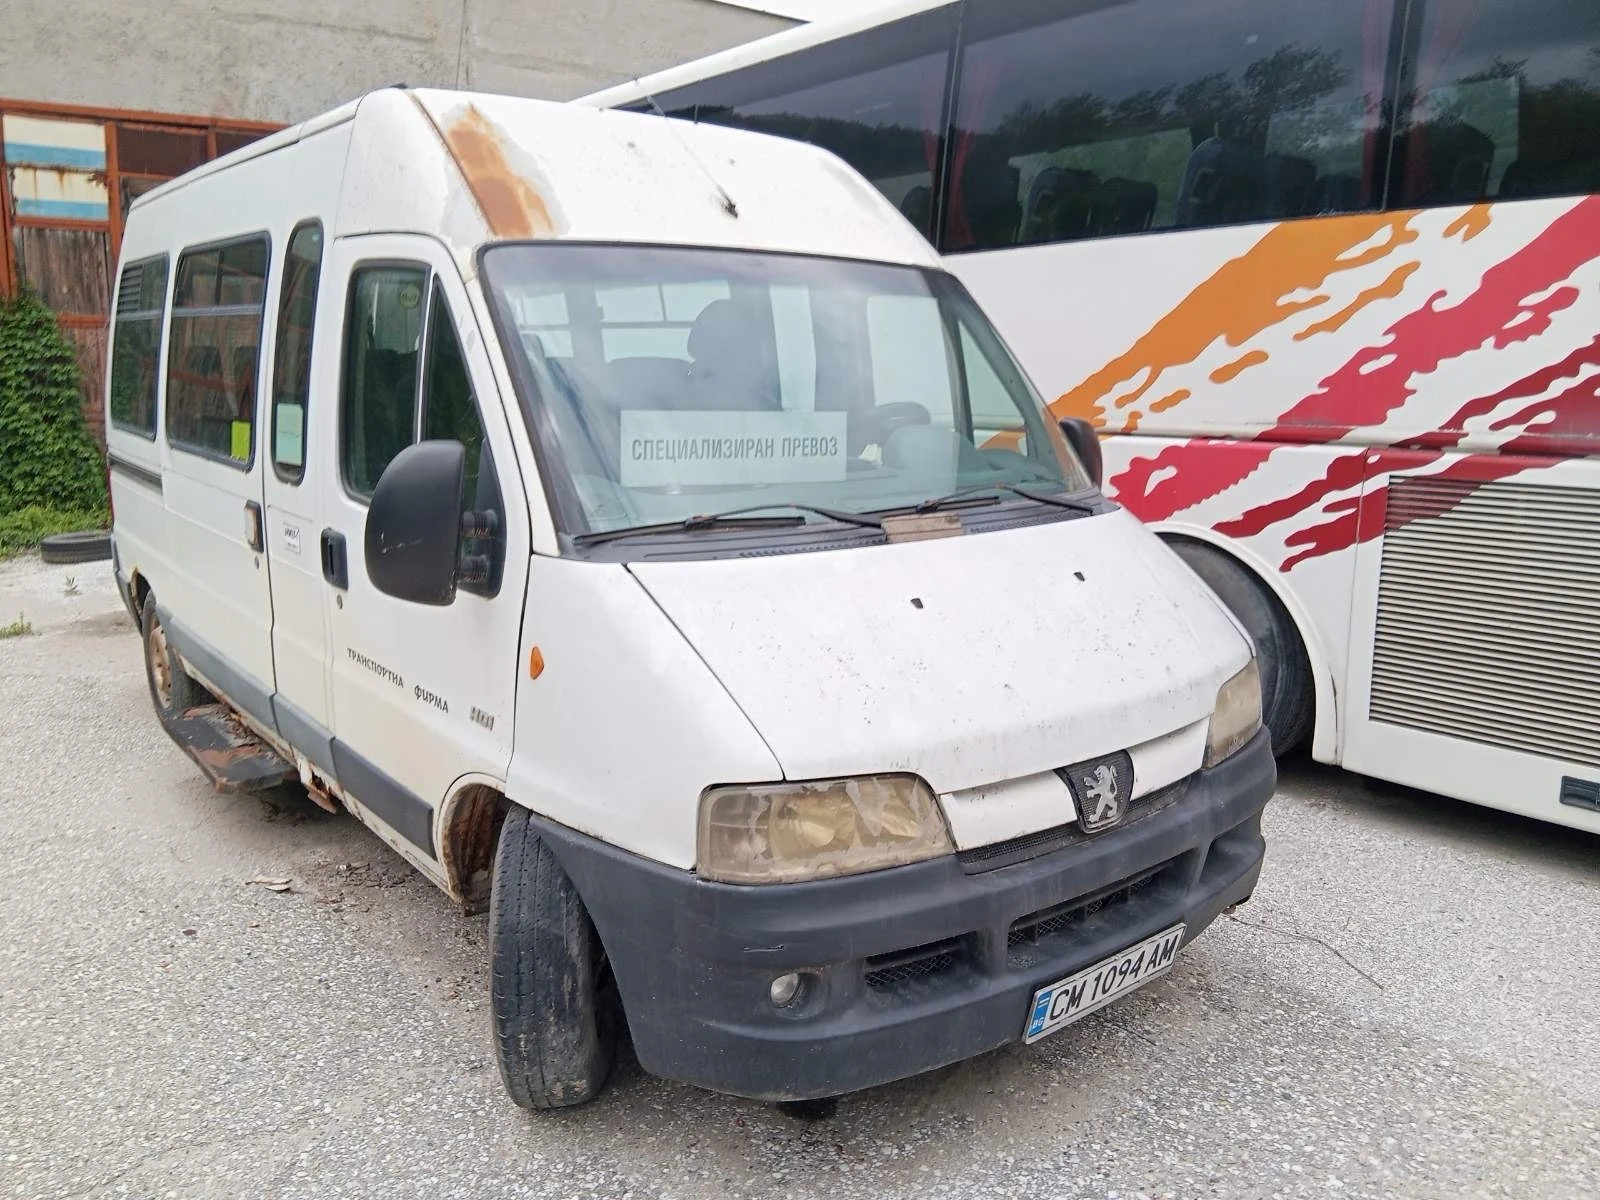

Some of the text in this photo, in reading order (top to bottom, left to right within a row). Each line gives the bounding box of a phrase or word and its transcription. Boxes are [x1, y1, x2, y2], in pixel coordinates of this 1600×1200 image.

[631, 436, 838, 463] СПЕЦИАЛИЗИРАН ПРЕВОЗ
[346, 648, 449, 713] ТРАНСПОРТНА ФИРМА
[1050, 934, 1179, 1020] CM 1094 AM
